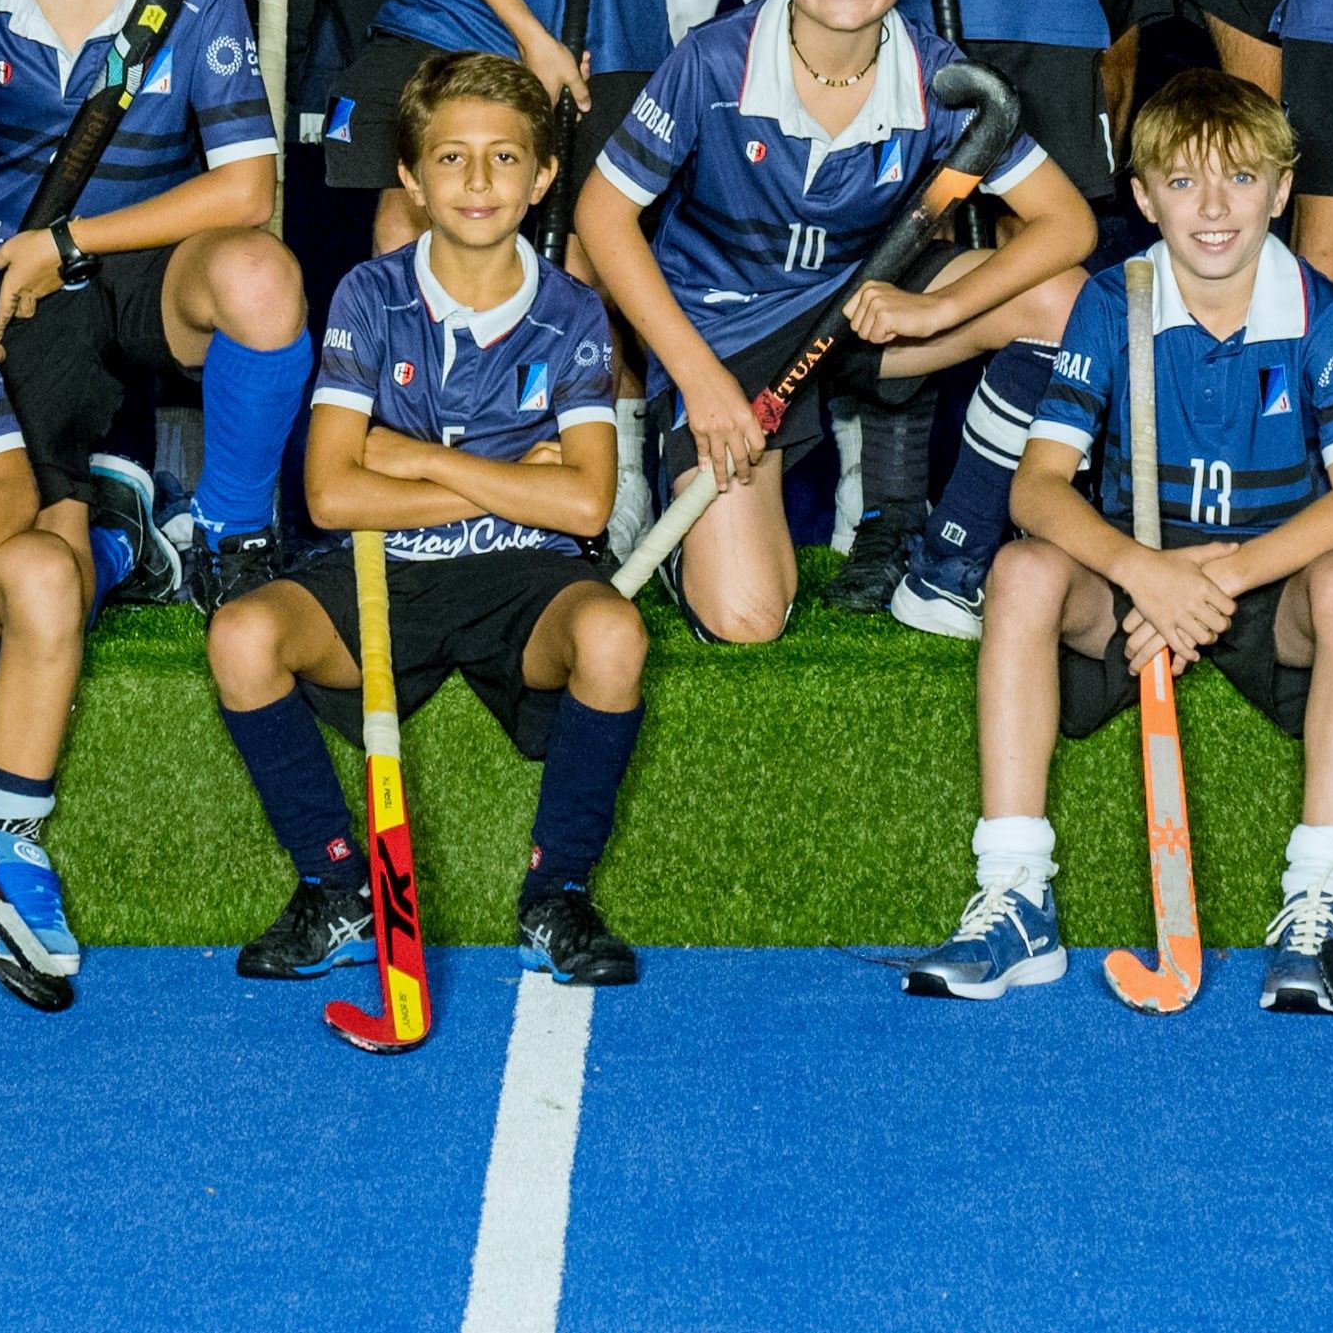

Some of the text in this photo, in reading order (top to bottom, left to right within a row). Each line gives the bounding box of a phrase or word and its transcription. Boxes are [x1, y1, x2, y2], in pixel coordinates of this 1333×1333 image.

[784, 222, 828, 273] 10
[1190, 457, 1233, 527] 13
[467, 516, 548, 556] Cuba
[376, 835, 417, 966] TK
